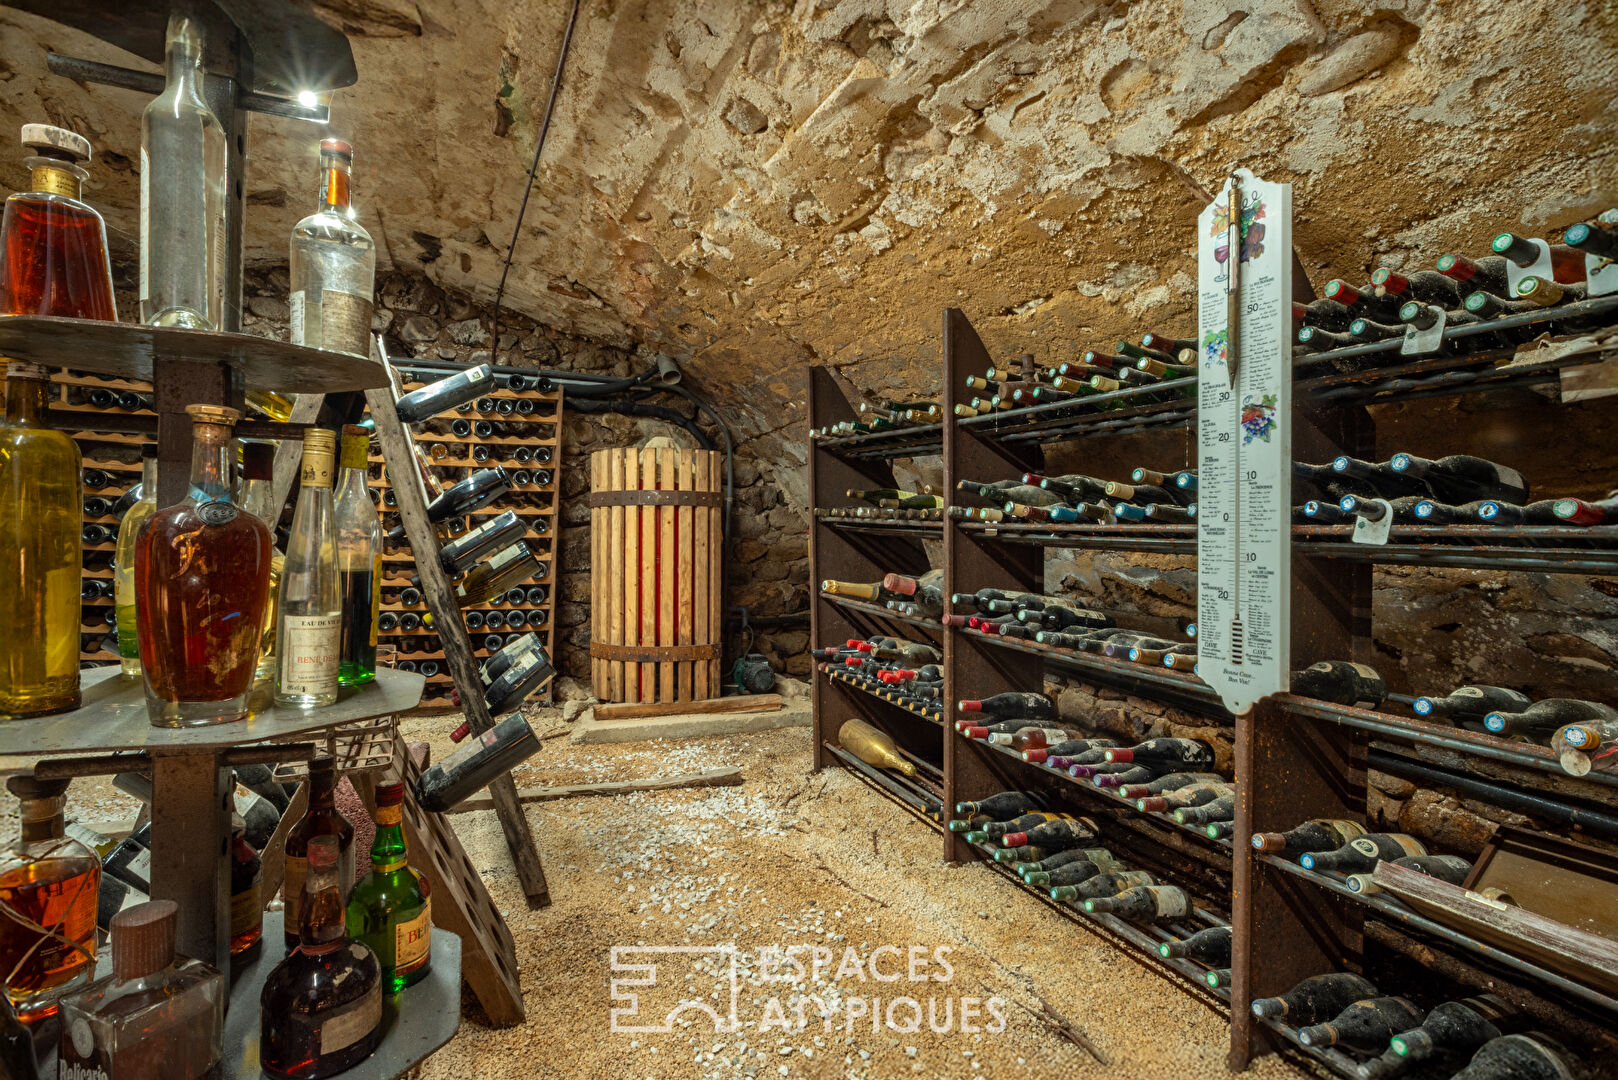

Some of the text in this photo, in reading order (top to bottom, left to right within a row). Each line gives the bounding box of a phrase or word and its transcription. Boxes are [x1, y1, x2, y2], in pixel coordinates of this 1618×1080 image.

[1247, 303, 1259, 314] 50
[1218, 391, 1230, 401] 30
[1218, 432, 1230, 442] 20
[1246, 470, 1257, 480] 10
[1223, 512, 1229, 521] 0
[1246, 552, 1257, 562] 10
[1218, 590, 1229, 600] 20
